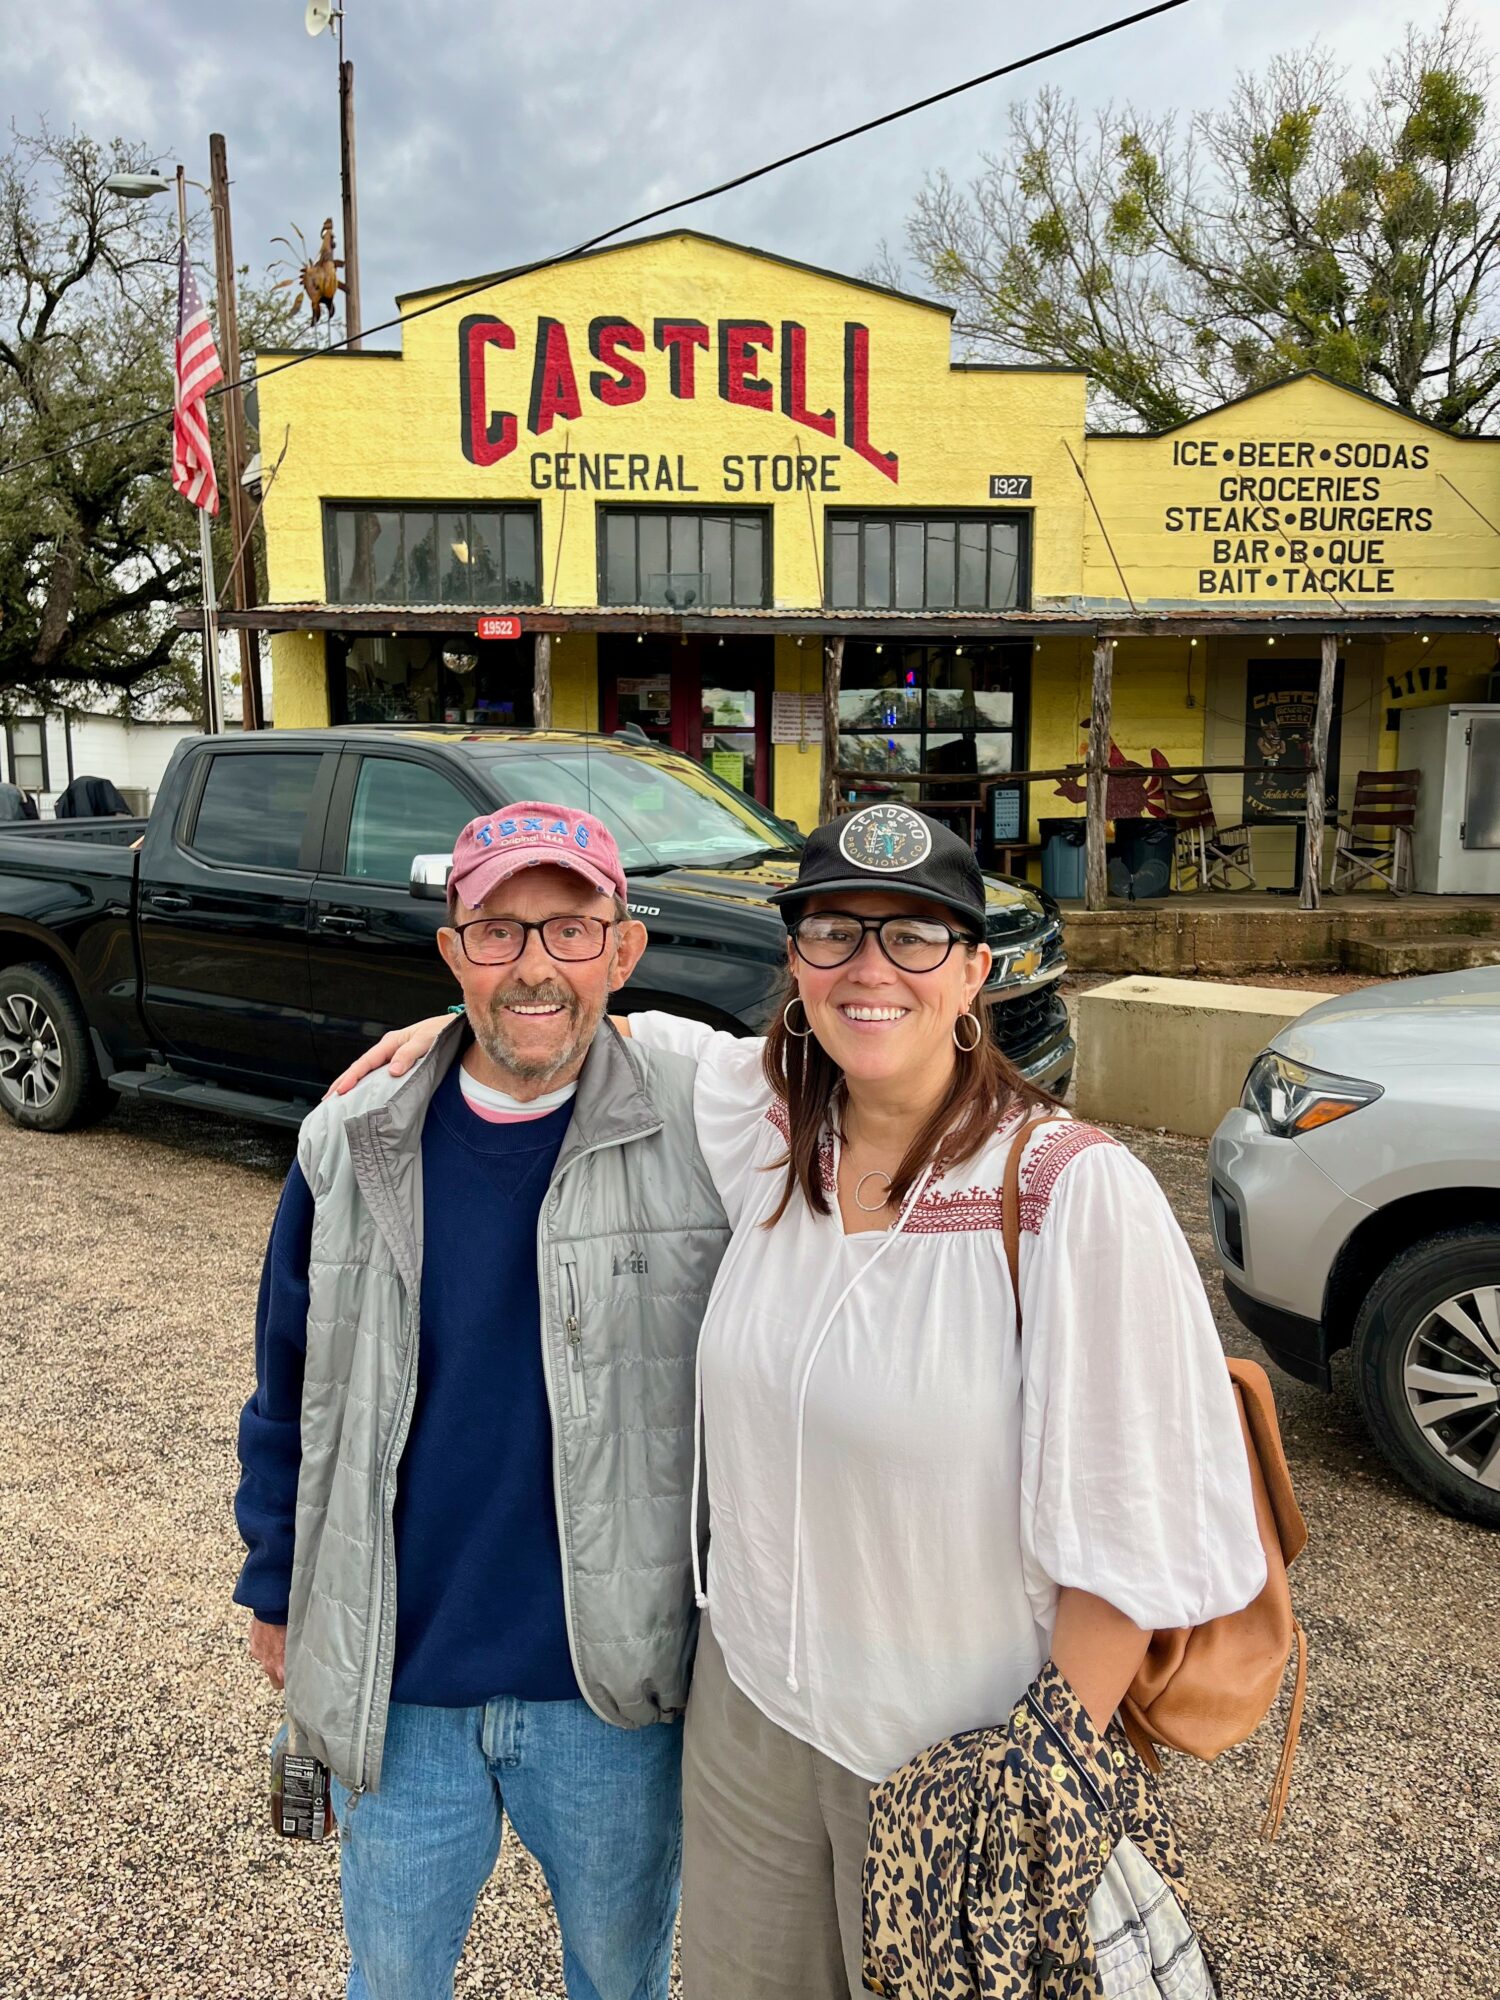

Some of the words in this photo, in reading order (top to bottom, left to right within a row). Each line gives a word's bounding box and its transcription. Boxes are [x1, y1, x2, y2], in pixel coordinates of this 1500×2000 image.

[458, 313, 900, 486] CASTELL
[1173, 440, 1219, 467] ICE
[1238, 441, 1315, 468] BEER
[1334, 442, 1430, 470] SODAS
[530, 451, 699, 492] GENERAL
[723, 454, 842, 493] STORE
[992, 477, 1029, 496] 1927
[1219, 476, 1381, 502] GROCERIES
[1165, 506, 1280, 532] STEAKS
[1299, 506, 1433, 532] BURGERS
[1198, 569, 1262, 594] BAIT
[1282, 568, 1395, 594] TACKLE
[482, 620, 514, 636] 19522
[1387, 665, 1448, 699] LIVE
[1252, 690, 1337, 710] CASTEL
[476, 817, 590, 849] TEXAS
[850, 808, 925, 840] SENDERO
[500, 833, 540, 847] Original
[847, 836, 908, 867] PROVISIONS
